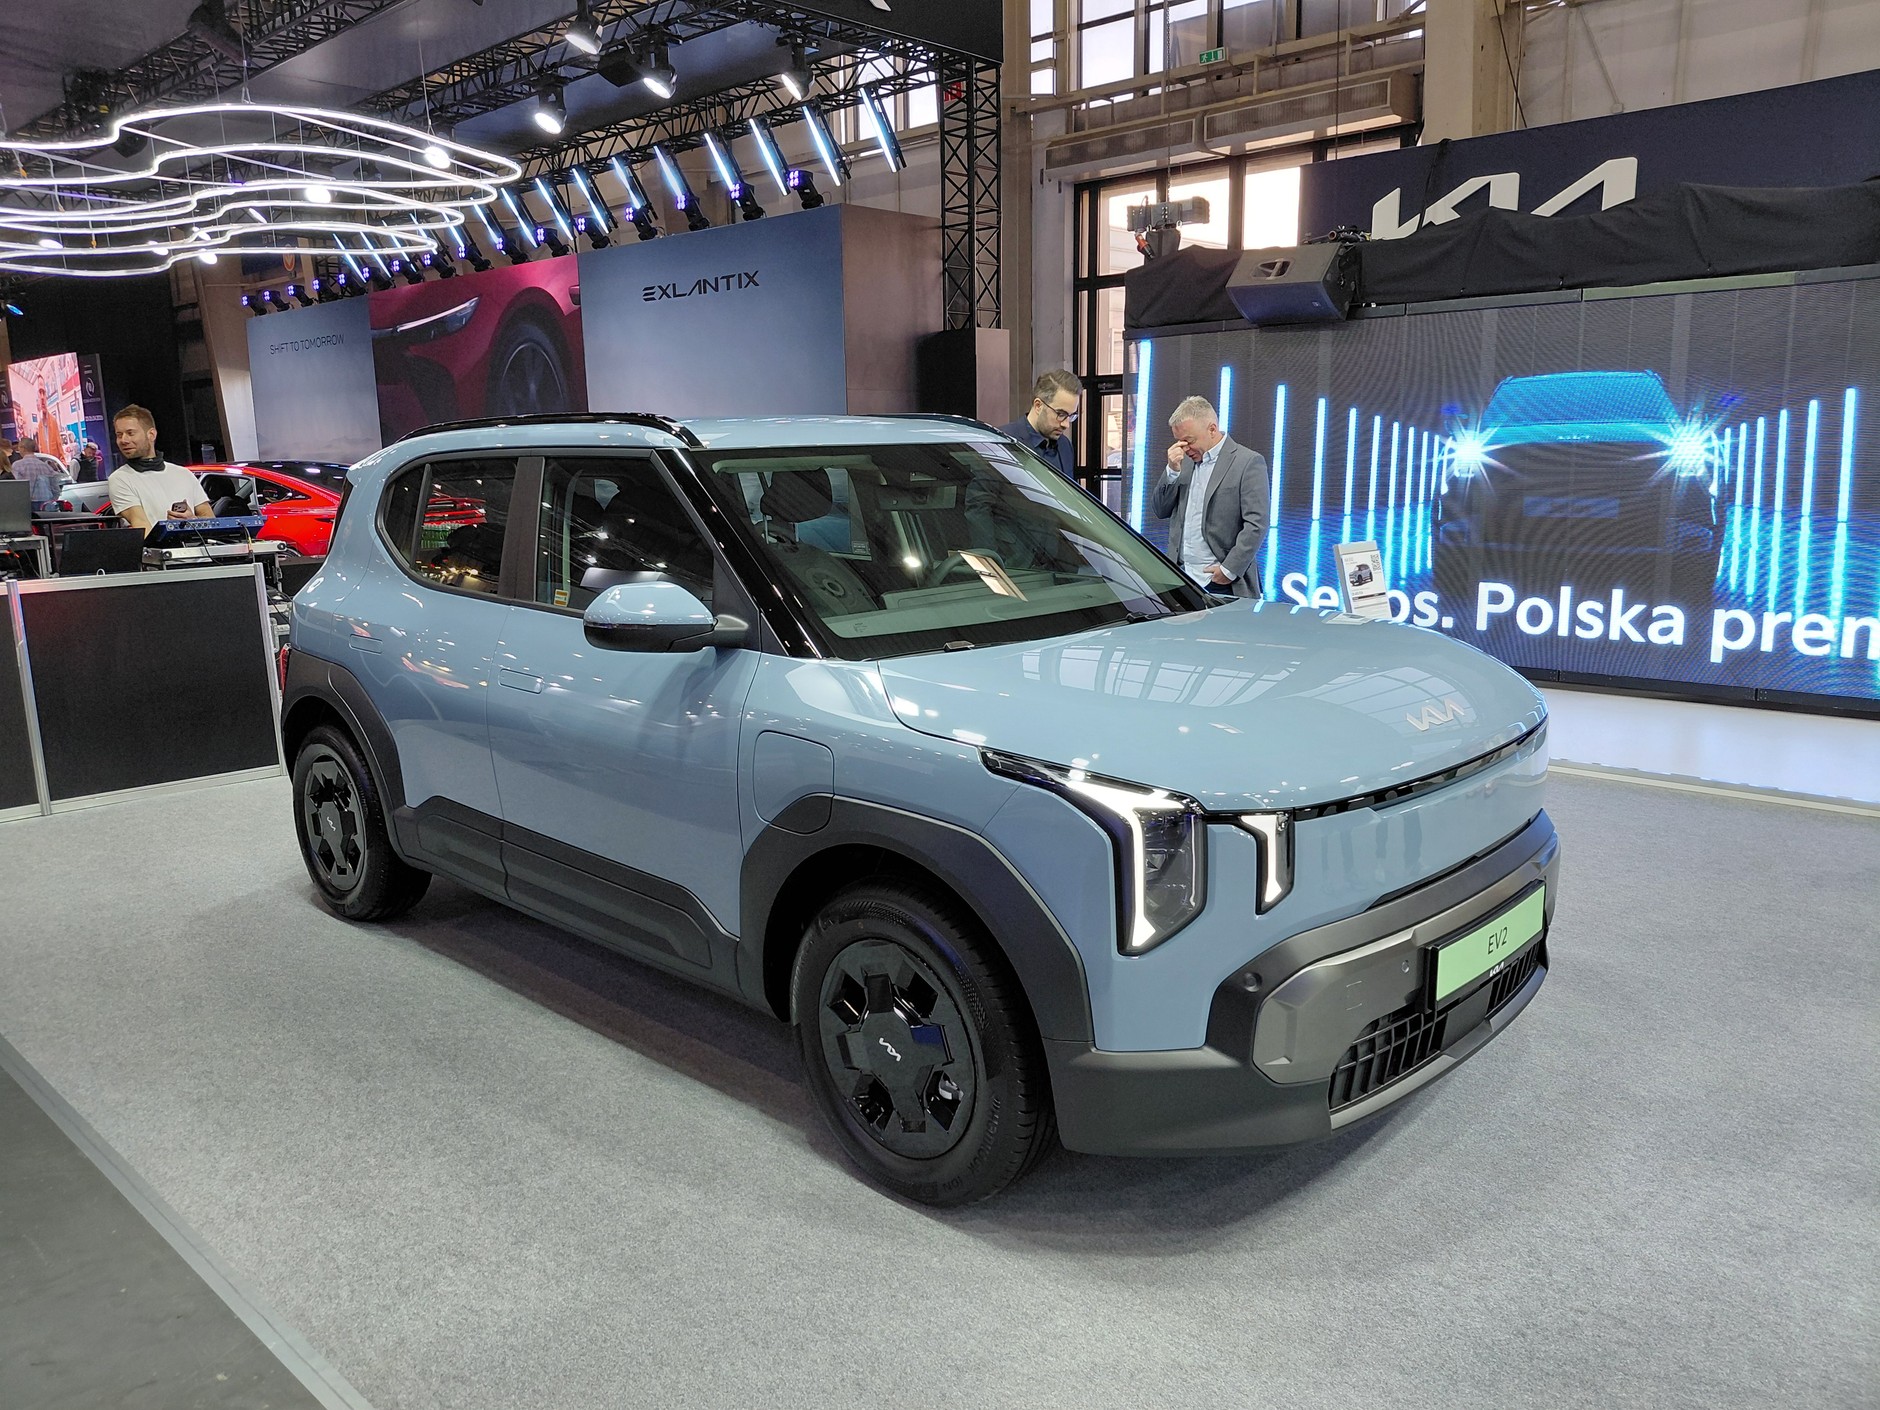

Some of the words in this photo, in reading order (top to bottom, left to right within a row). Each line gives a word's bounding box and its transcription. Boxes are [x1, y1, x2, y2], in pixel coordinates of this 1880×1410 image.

[642, 270, 760, 302] EXLANTIX
[270, 342, 289, 355] SHIFT
[290, 341, 299, 352] TO
[300, 334, 345, 350] TOMORROW
[1281, 572, 1454, 628] Seos.
[1476, 581, 1686, 646] Polska
[1405, 697, 1466, 733] KIA
[1488, 926, 1508, 955] EV2
